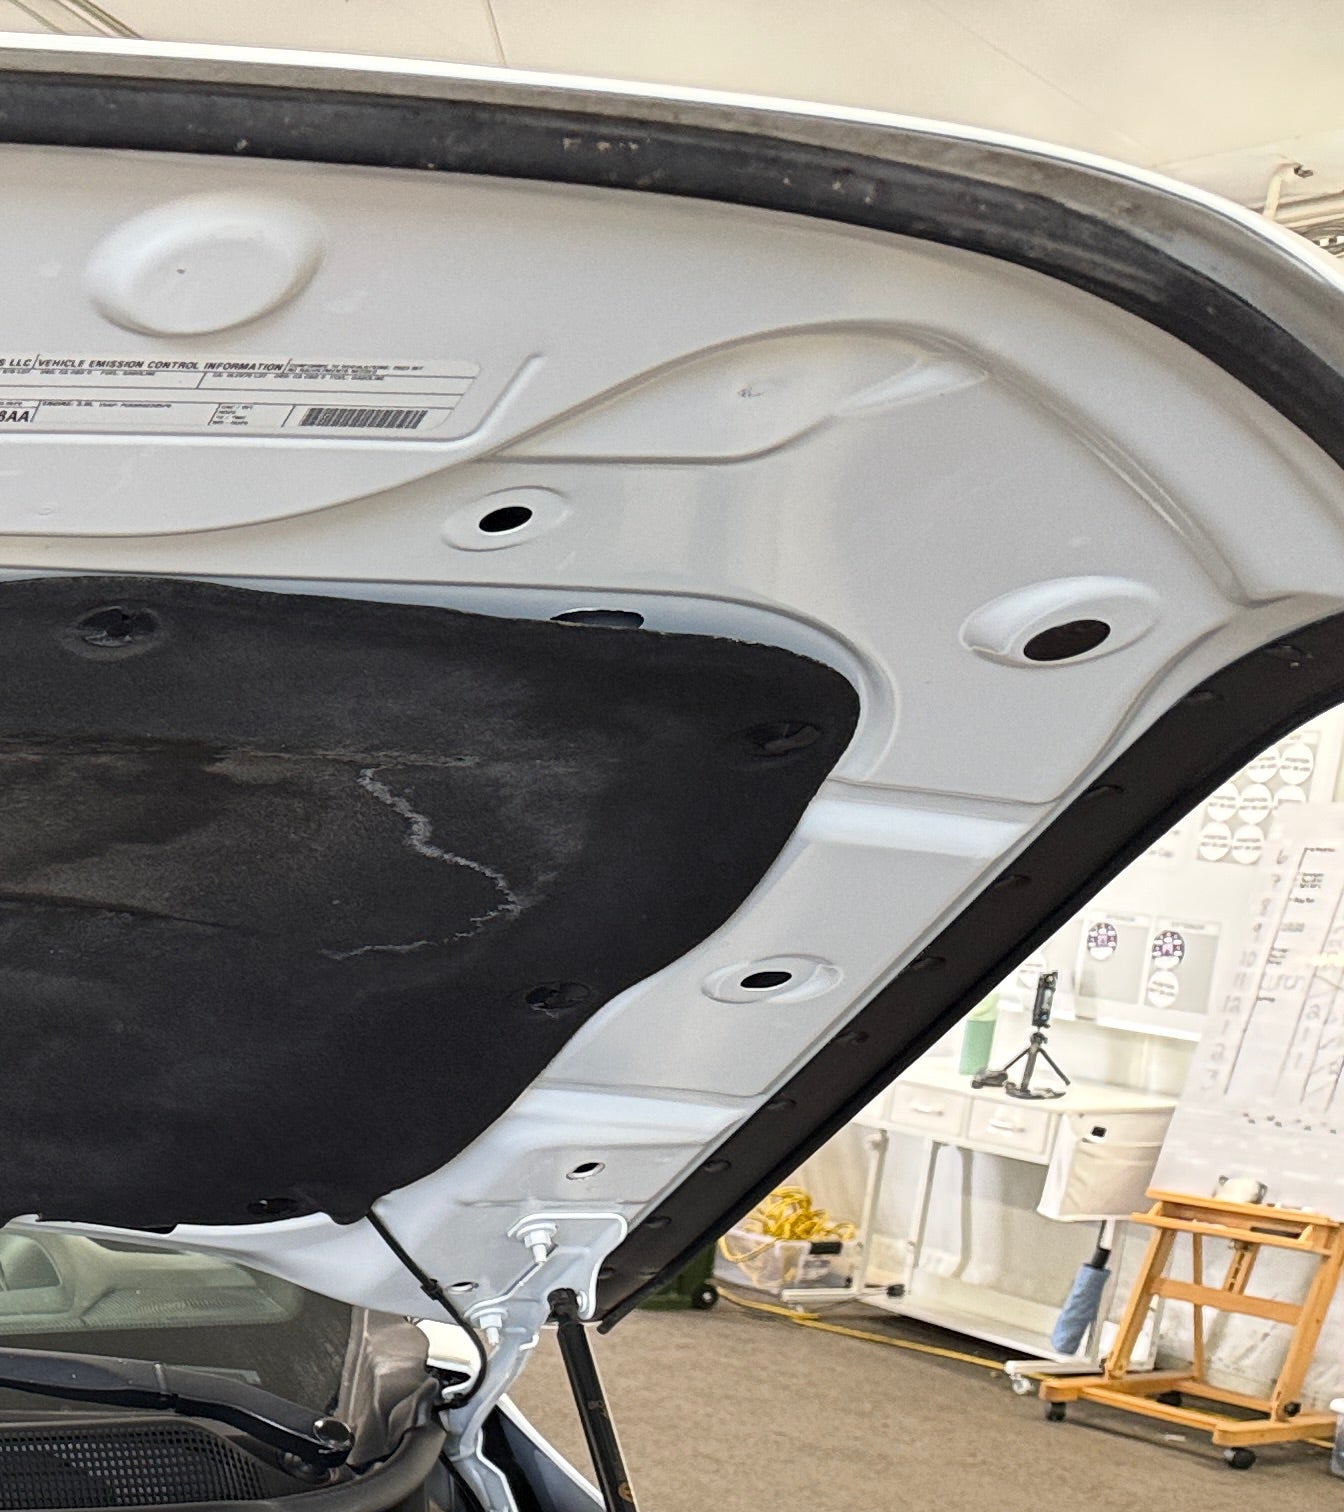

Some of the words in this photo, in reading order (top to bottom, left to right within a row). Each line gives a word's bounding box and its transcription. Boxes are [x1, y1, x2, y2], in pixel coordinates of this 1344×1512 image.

[9, 358, 33, 368] LLC
[38, 359, 85, 369] VEHICLE
[89, 360, 144, 370] EMISSION
[147, 361, 199, 371] CONTROL
[203, 362, 284, 373] INFORMATION
